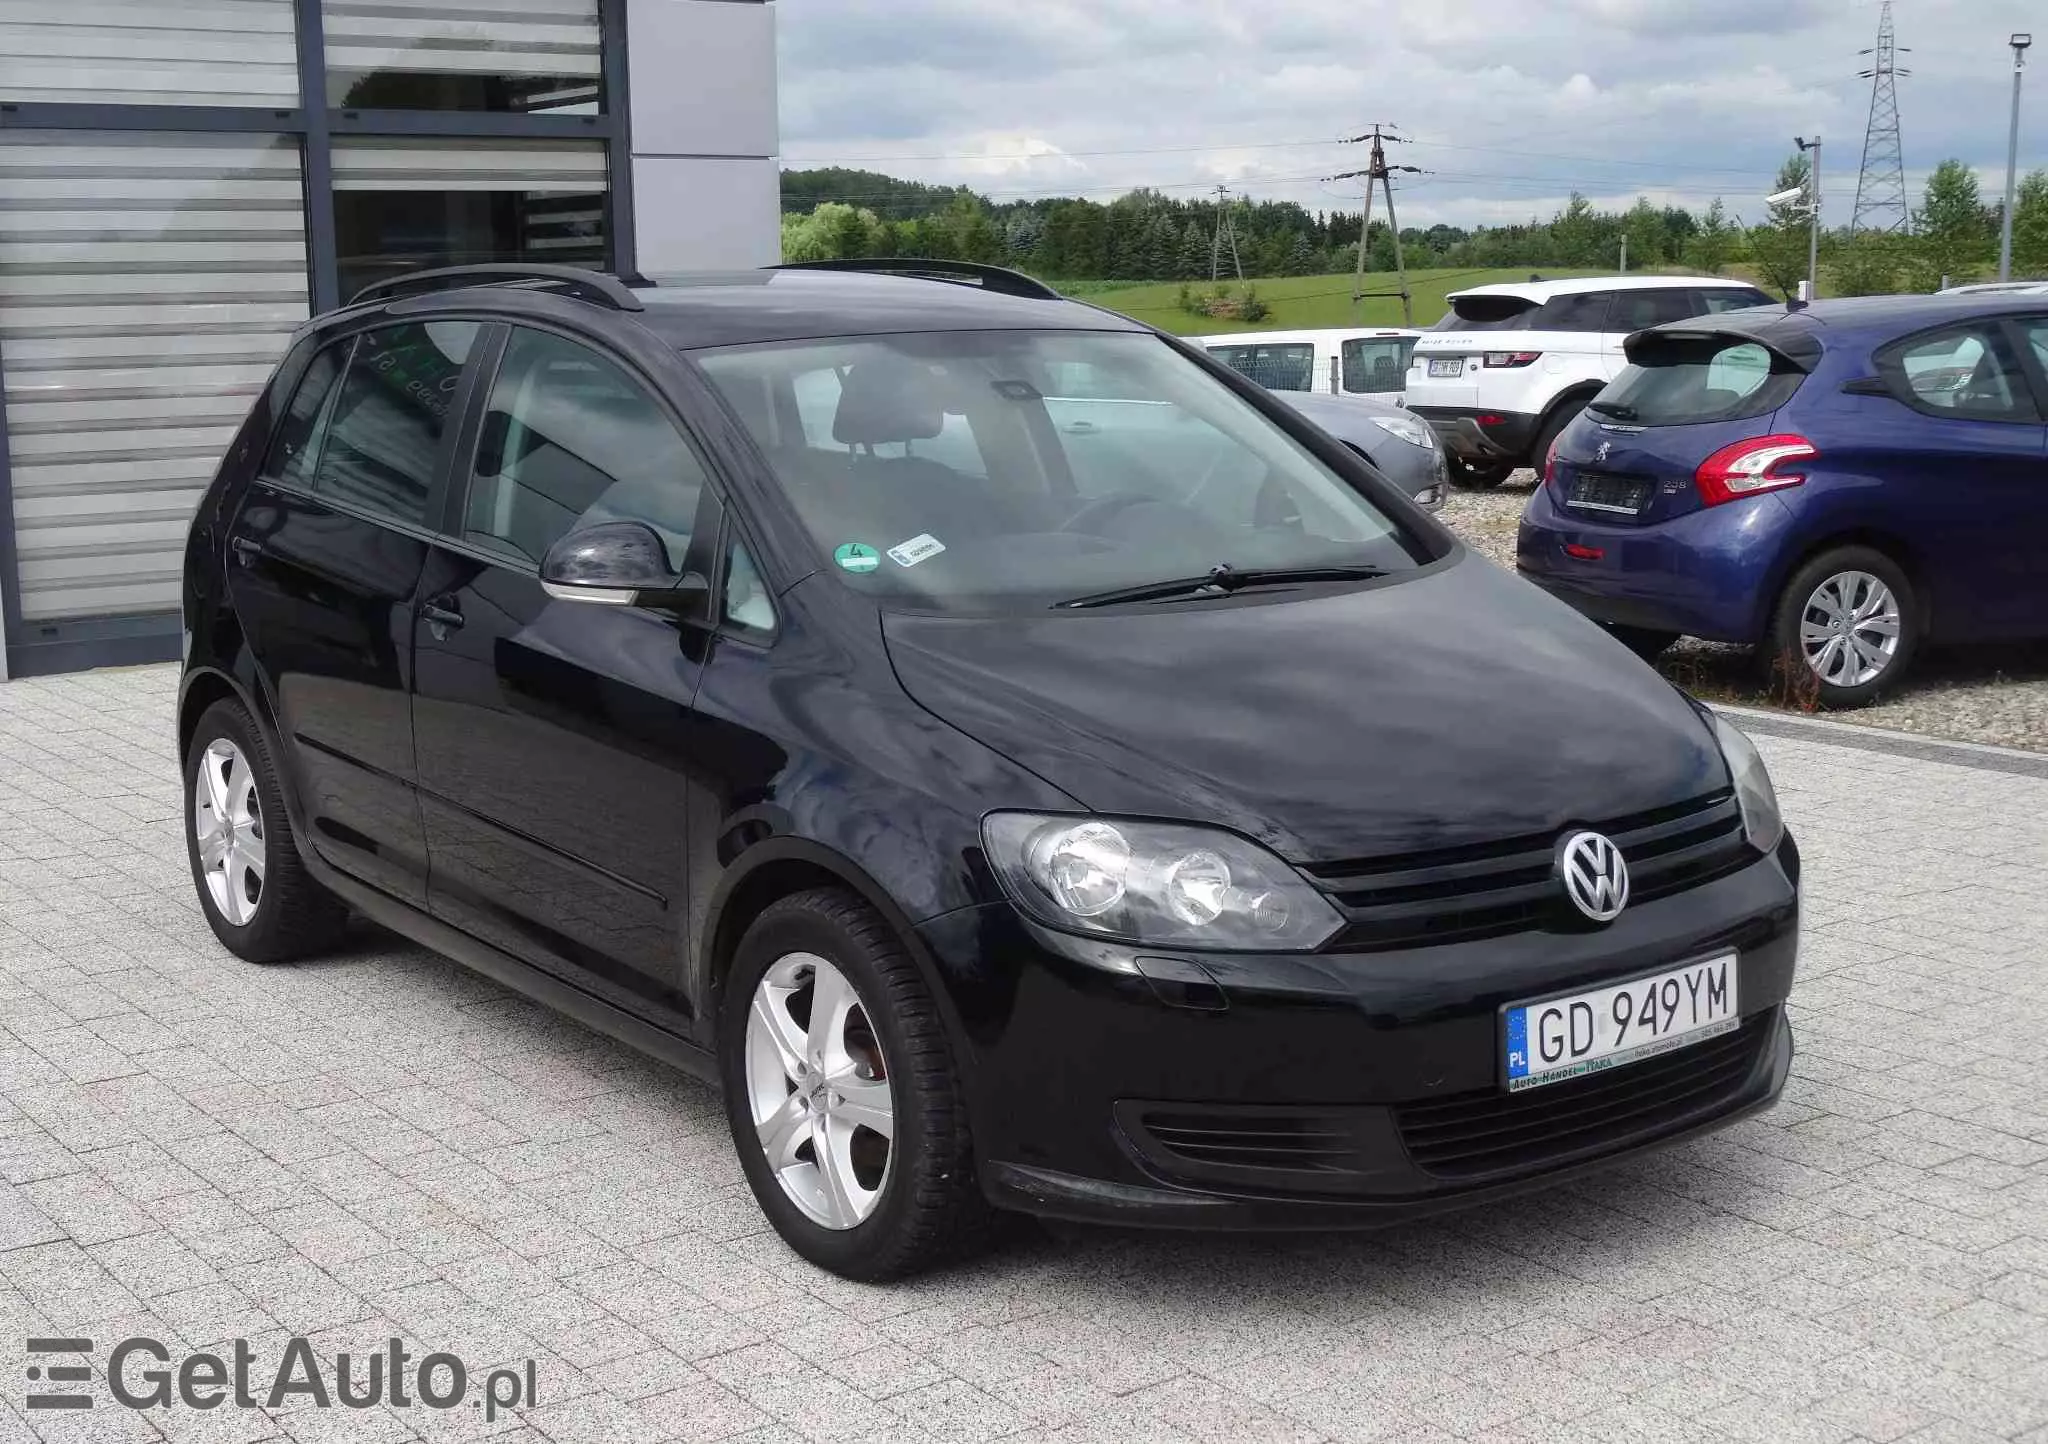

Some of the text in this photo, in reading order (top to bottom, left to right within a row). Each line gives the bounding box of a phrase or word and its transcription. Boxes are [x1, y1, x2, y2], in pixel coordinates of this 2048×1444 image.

[850, 543, 863, 557] 4
[1537, 962, 1727, 1063] GD 949YM
[1509, 1051, 1526, 1068] PL
